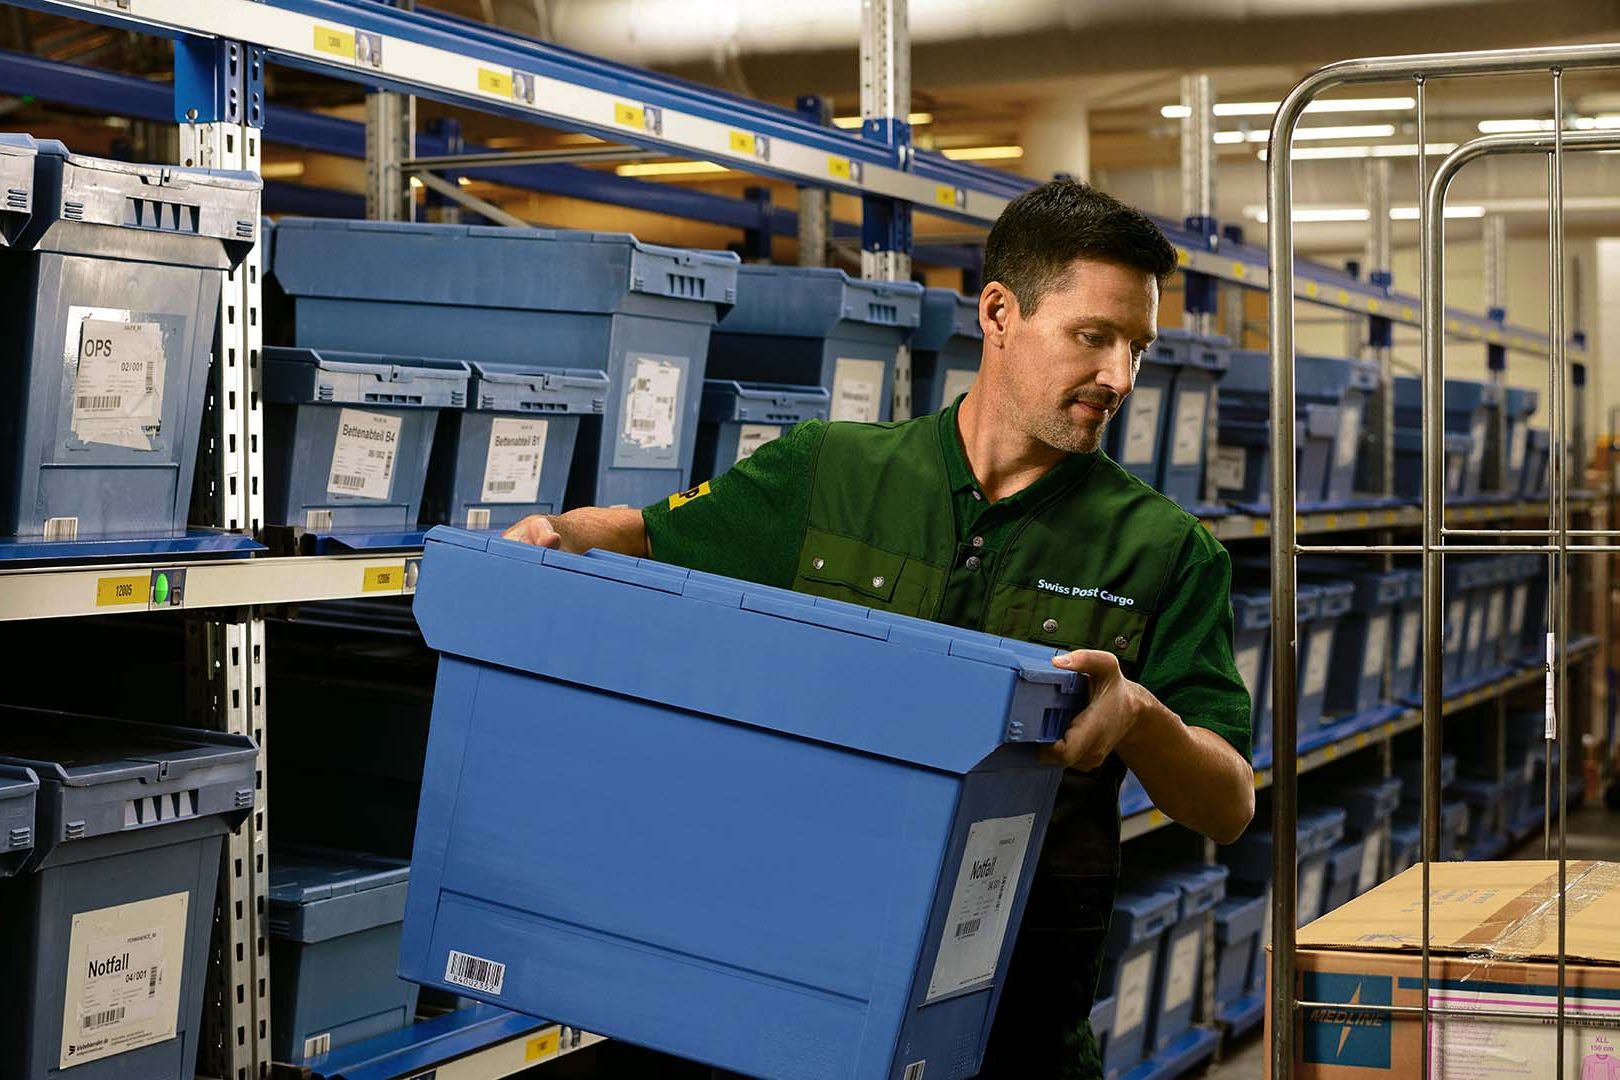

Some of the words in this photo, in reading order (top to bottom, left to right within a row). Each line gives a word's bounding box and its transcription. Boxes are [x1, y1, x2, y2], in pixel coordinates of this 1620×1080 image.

[84, 339, 112, 357] OPS
[121, 361, 143, 372] 02/001
[342, 423, 384, 441] Bettenabteil
[385, 431, 396, 442] B4
[495, 435, 531, 447] Bettenabteil
[116, 584, 133, 597] 12005
[1037, 579, 1070, 595] Swiss
[1071, 587, 1100, 598] Post
[1100, 590, 1134, 606] Cargo
[970, 856, 997, 880] Notfall
[88, 953, 129, 978] Notfall
[125, 969, 147, 984] 04/001
[1310, 1009, 1385, 1027] MEDLINE
